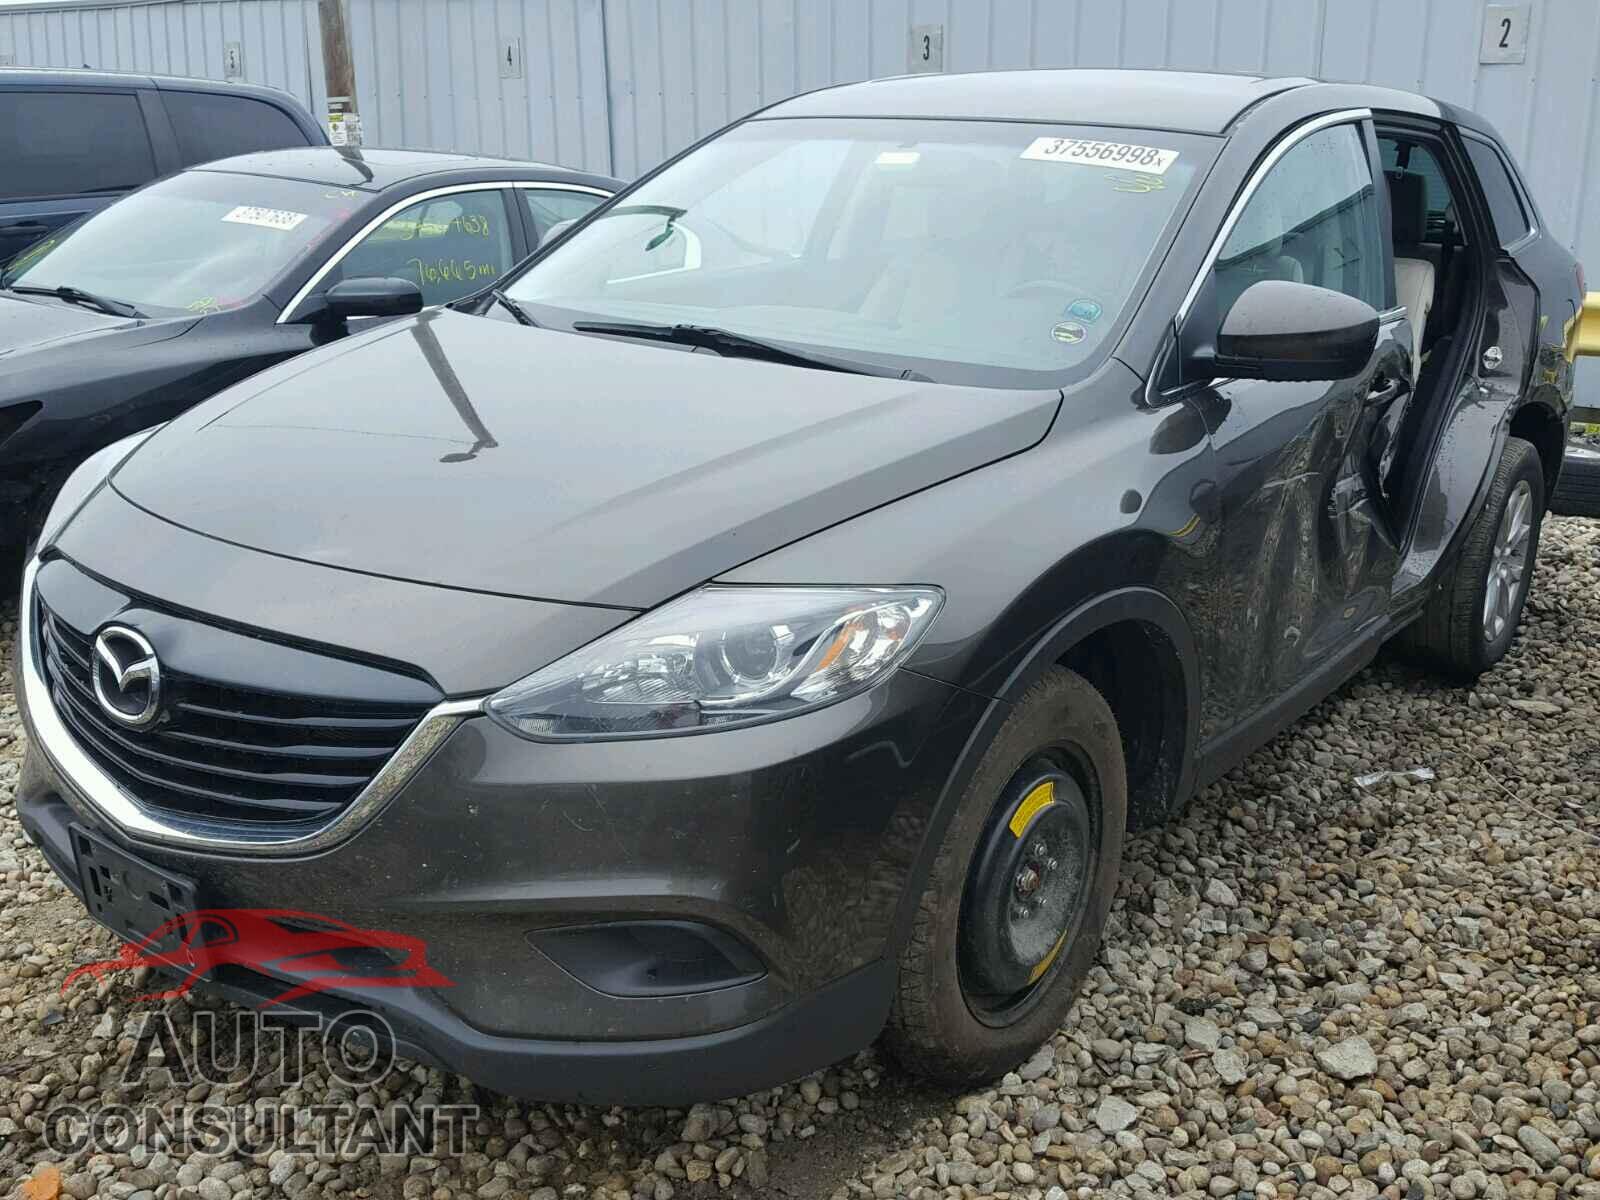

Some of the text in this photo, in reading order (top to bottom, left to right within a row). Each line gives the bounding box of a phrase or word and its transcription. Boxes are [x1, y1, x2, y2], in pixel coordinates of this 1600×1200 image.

[1498, 18, 1512, 48] 2
[505, 45, 513, 67] 4
[923, 34, 930, 61] 3
